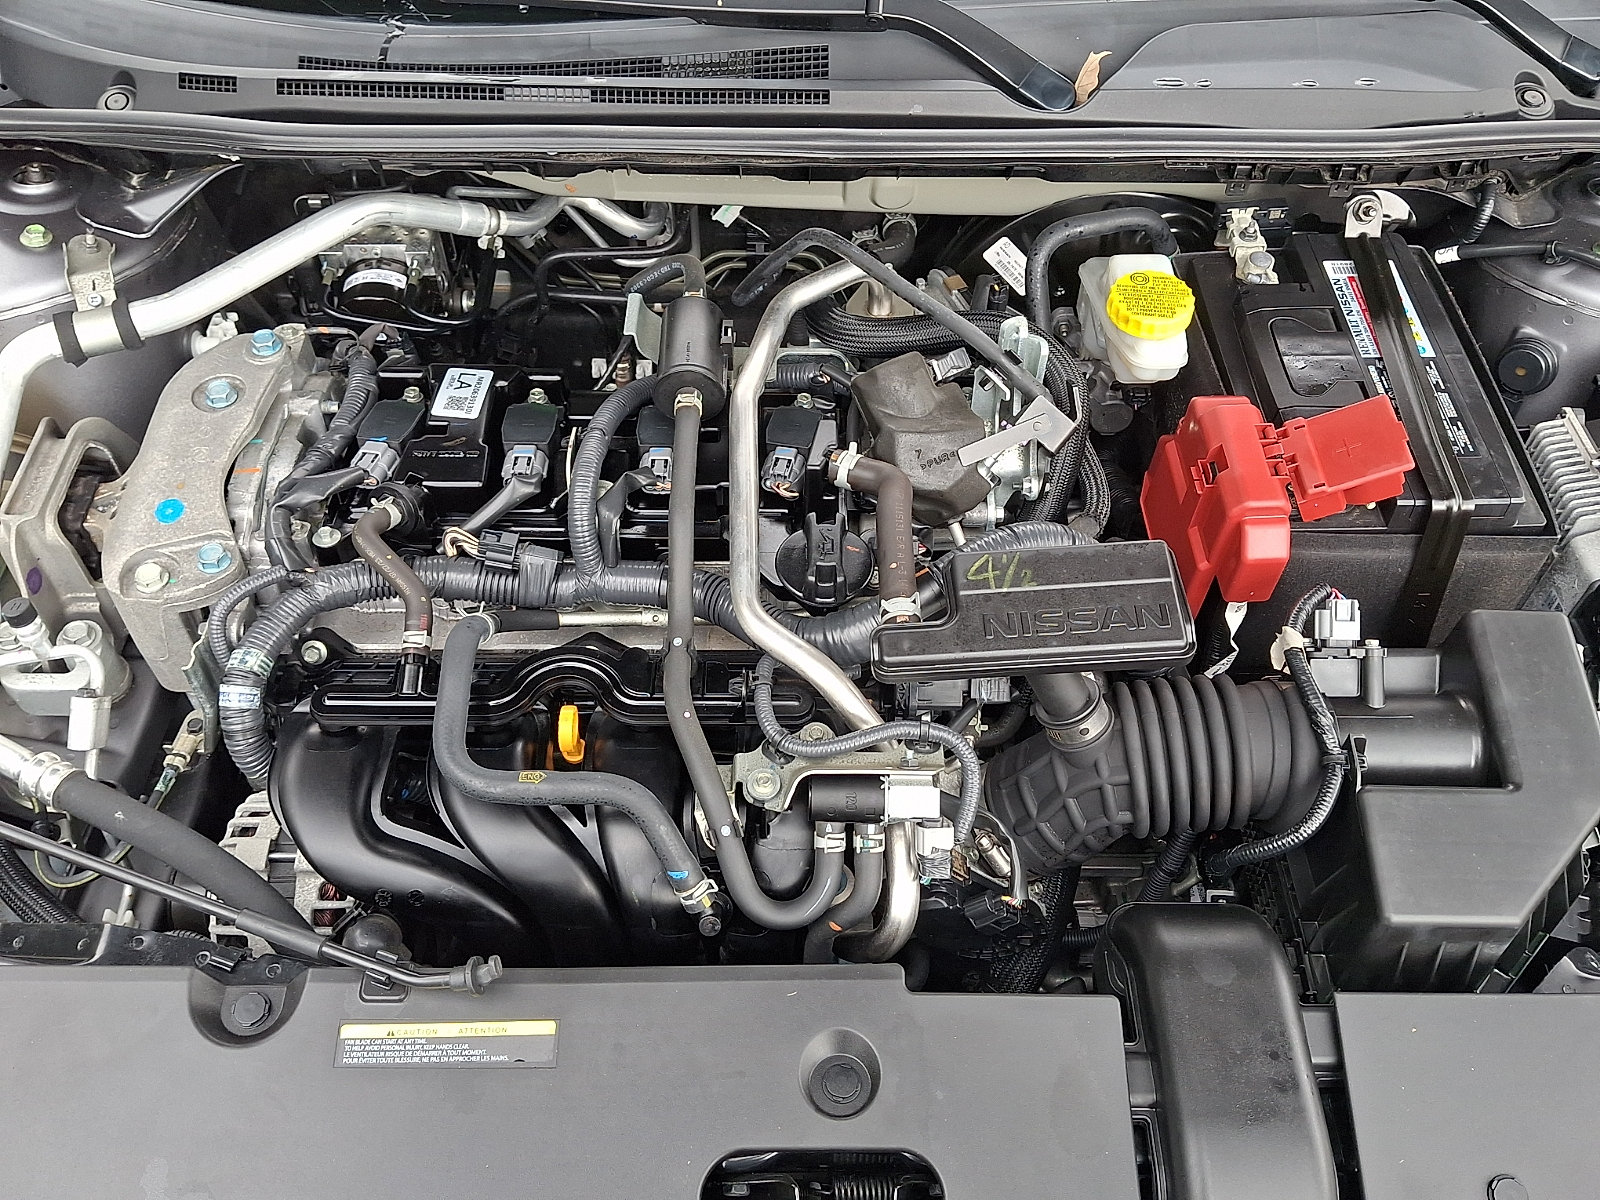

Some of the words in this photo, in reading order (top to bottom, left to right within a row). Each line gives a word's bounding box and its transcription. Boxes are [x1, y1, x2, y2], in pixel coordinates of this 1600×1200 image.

[1332, 278, 1356, 316] NISSAN
[1348, 319, 1372, 355] RENAULT
[453, 373, 478, 390] LA
[981, 602, 1172, 640] NISSAN
[396, 1028, 438, 1036] CAUTION
[458, 1027, 508, 1035] ATTENTION
